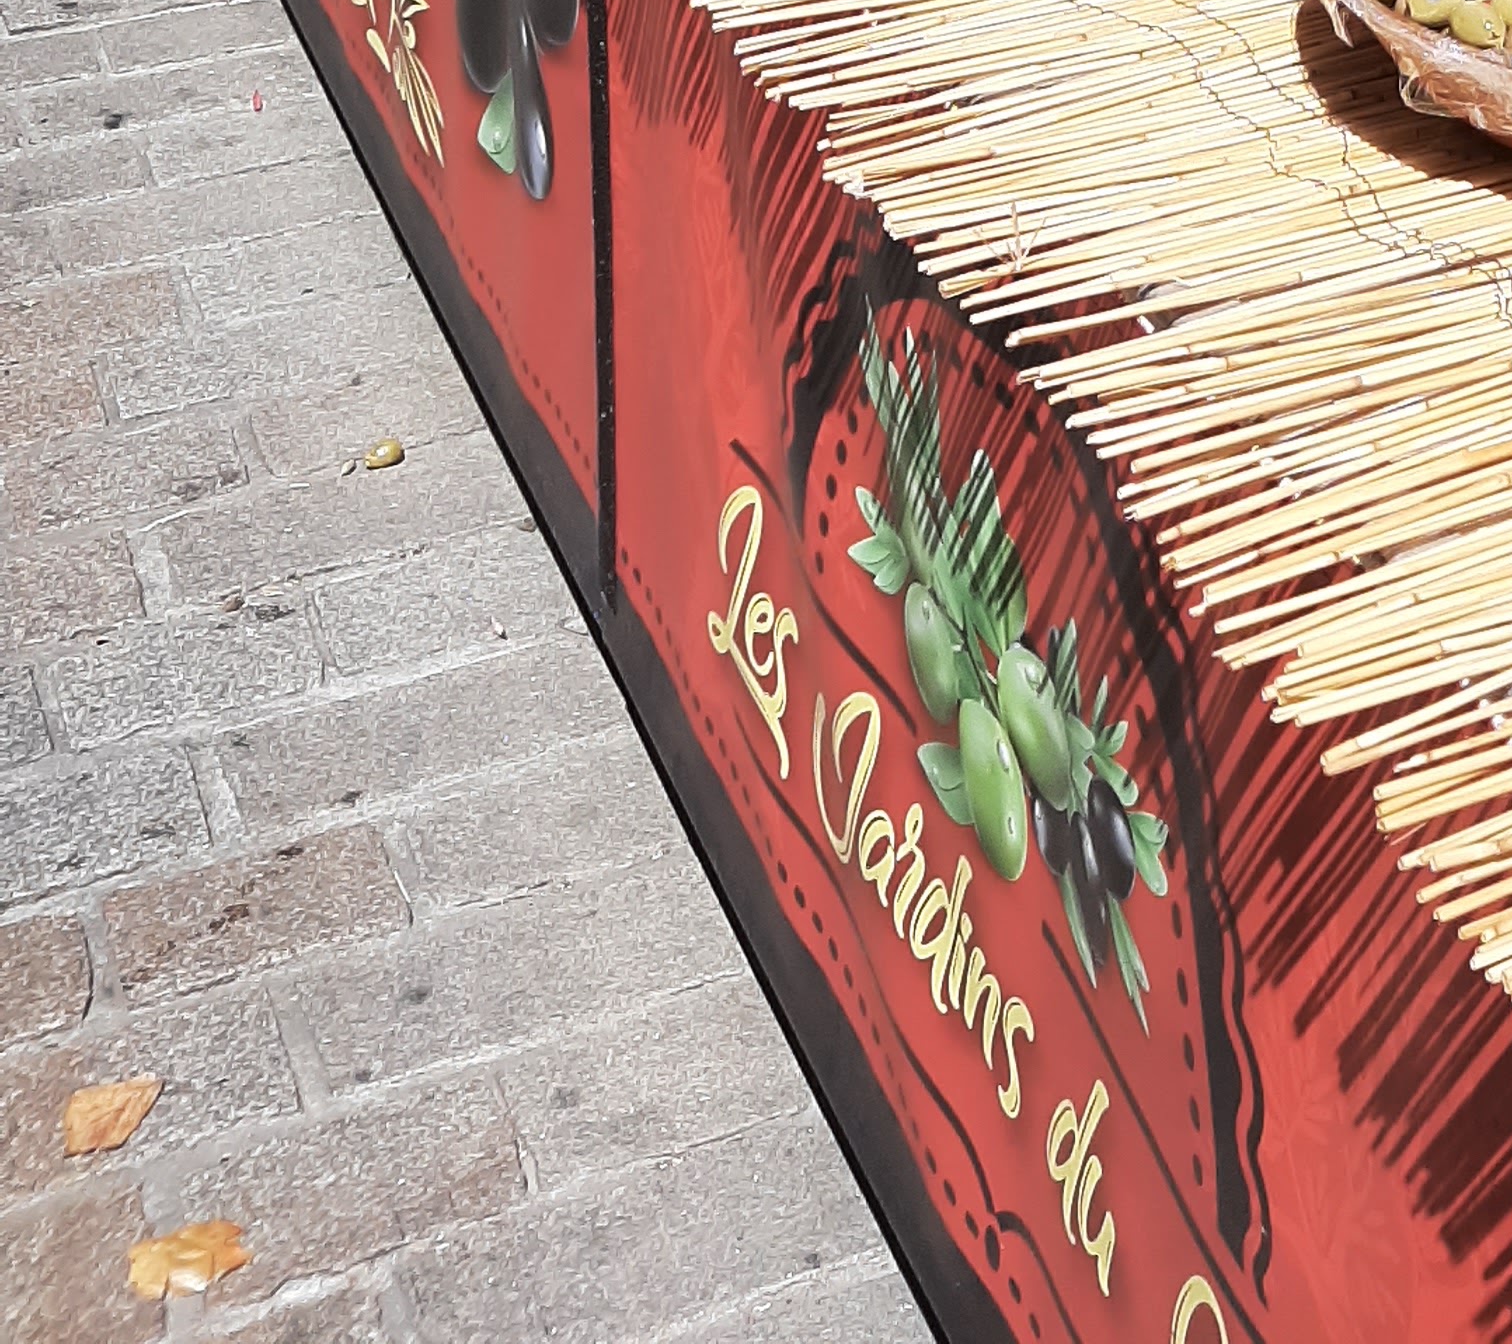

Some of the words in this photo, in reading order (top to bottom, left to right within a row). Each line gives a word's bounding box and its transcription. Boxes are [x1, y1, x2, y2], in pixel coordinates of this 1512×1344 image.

[708, 485, 799, 779] Les
[813, 692, 1035, 1118] Jardins
[1046, 1079, 1115, 1297] du
